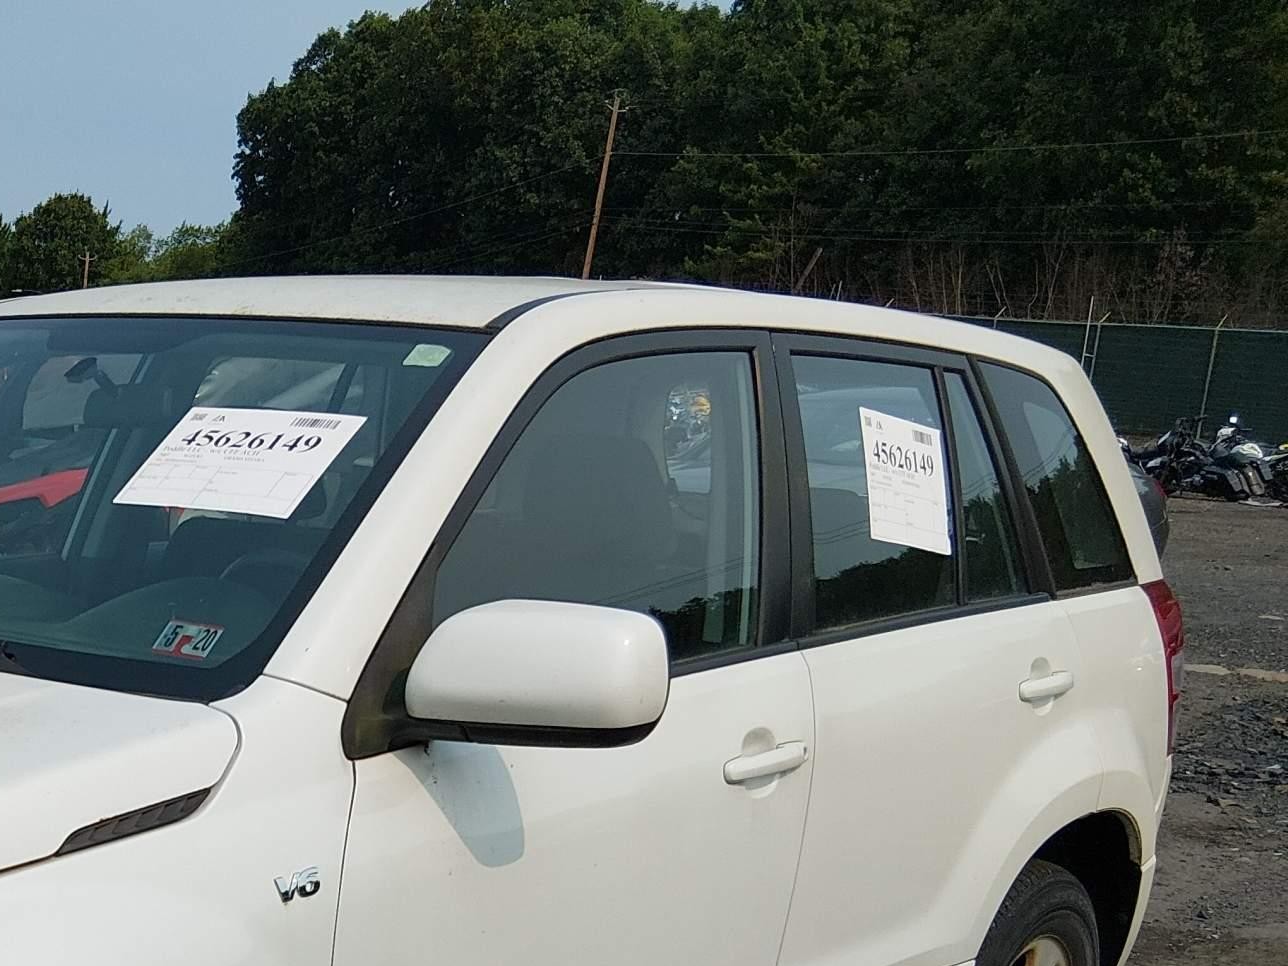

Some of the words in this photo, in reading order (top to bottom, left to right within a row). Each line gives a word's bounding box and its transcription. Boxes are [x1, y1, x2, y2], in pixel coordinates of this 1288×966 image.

[182, 428, 322, 453] 45626149
[873, 440, 934, 477] 45626149
[164, 625, 183, 648] 5
[192, 629, 218, 652] 20
[273, 865, 320, 904] V6
